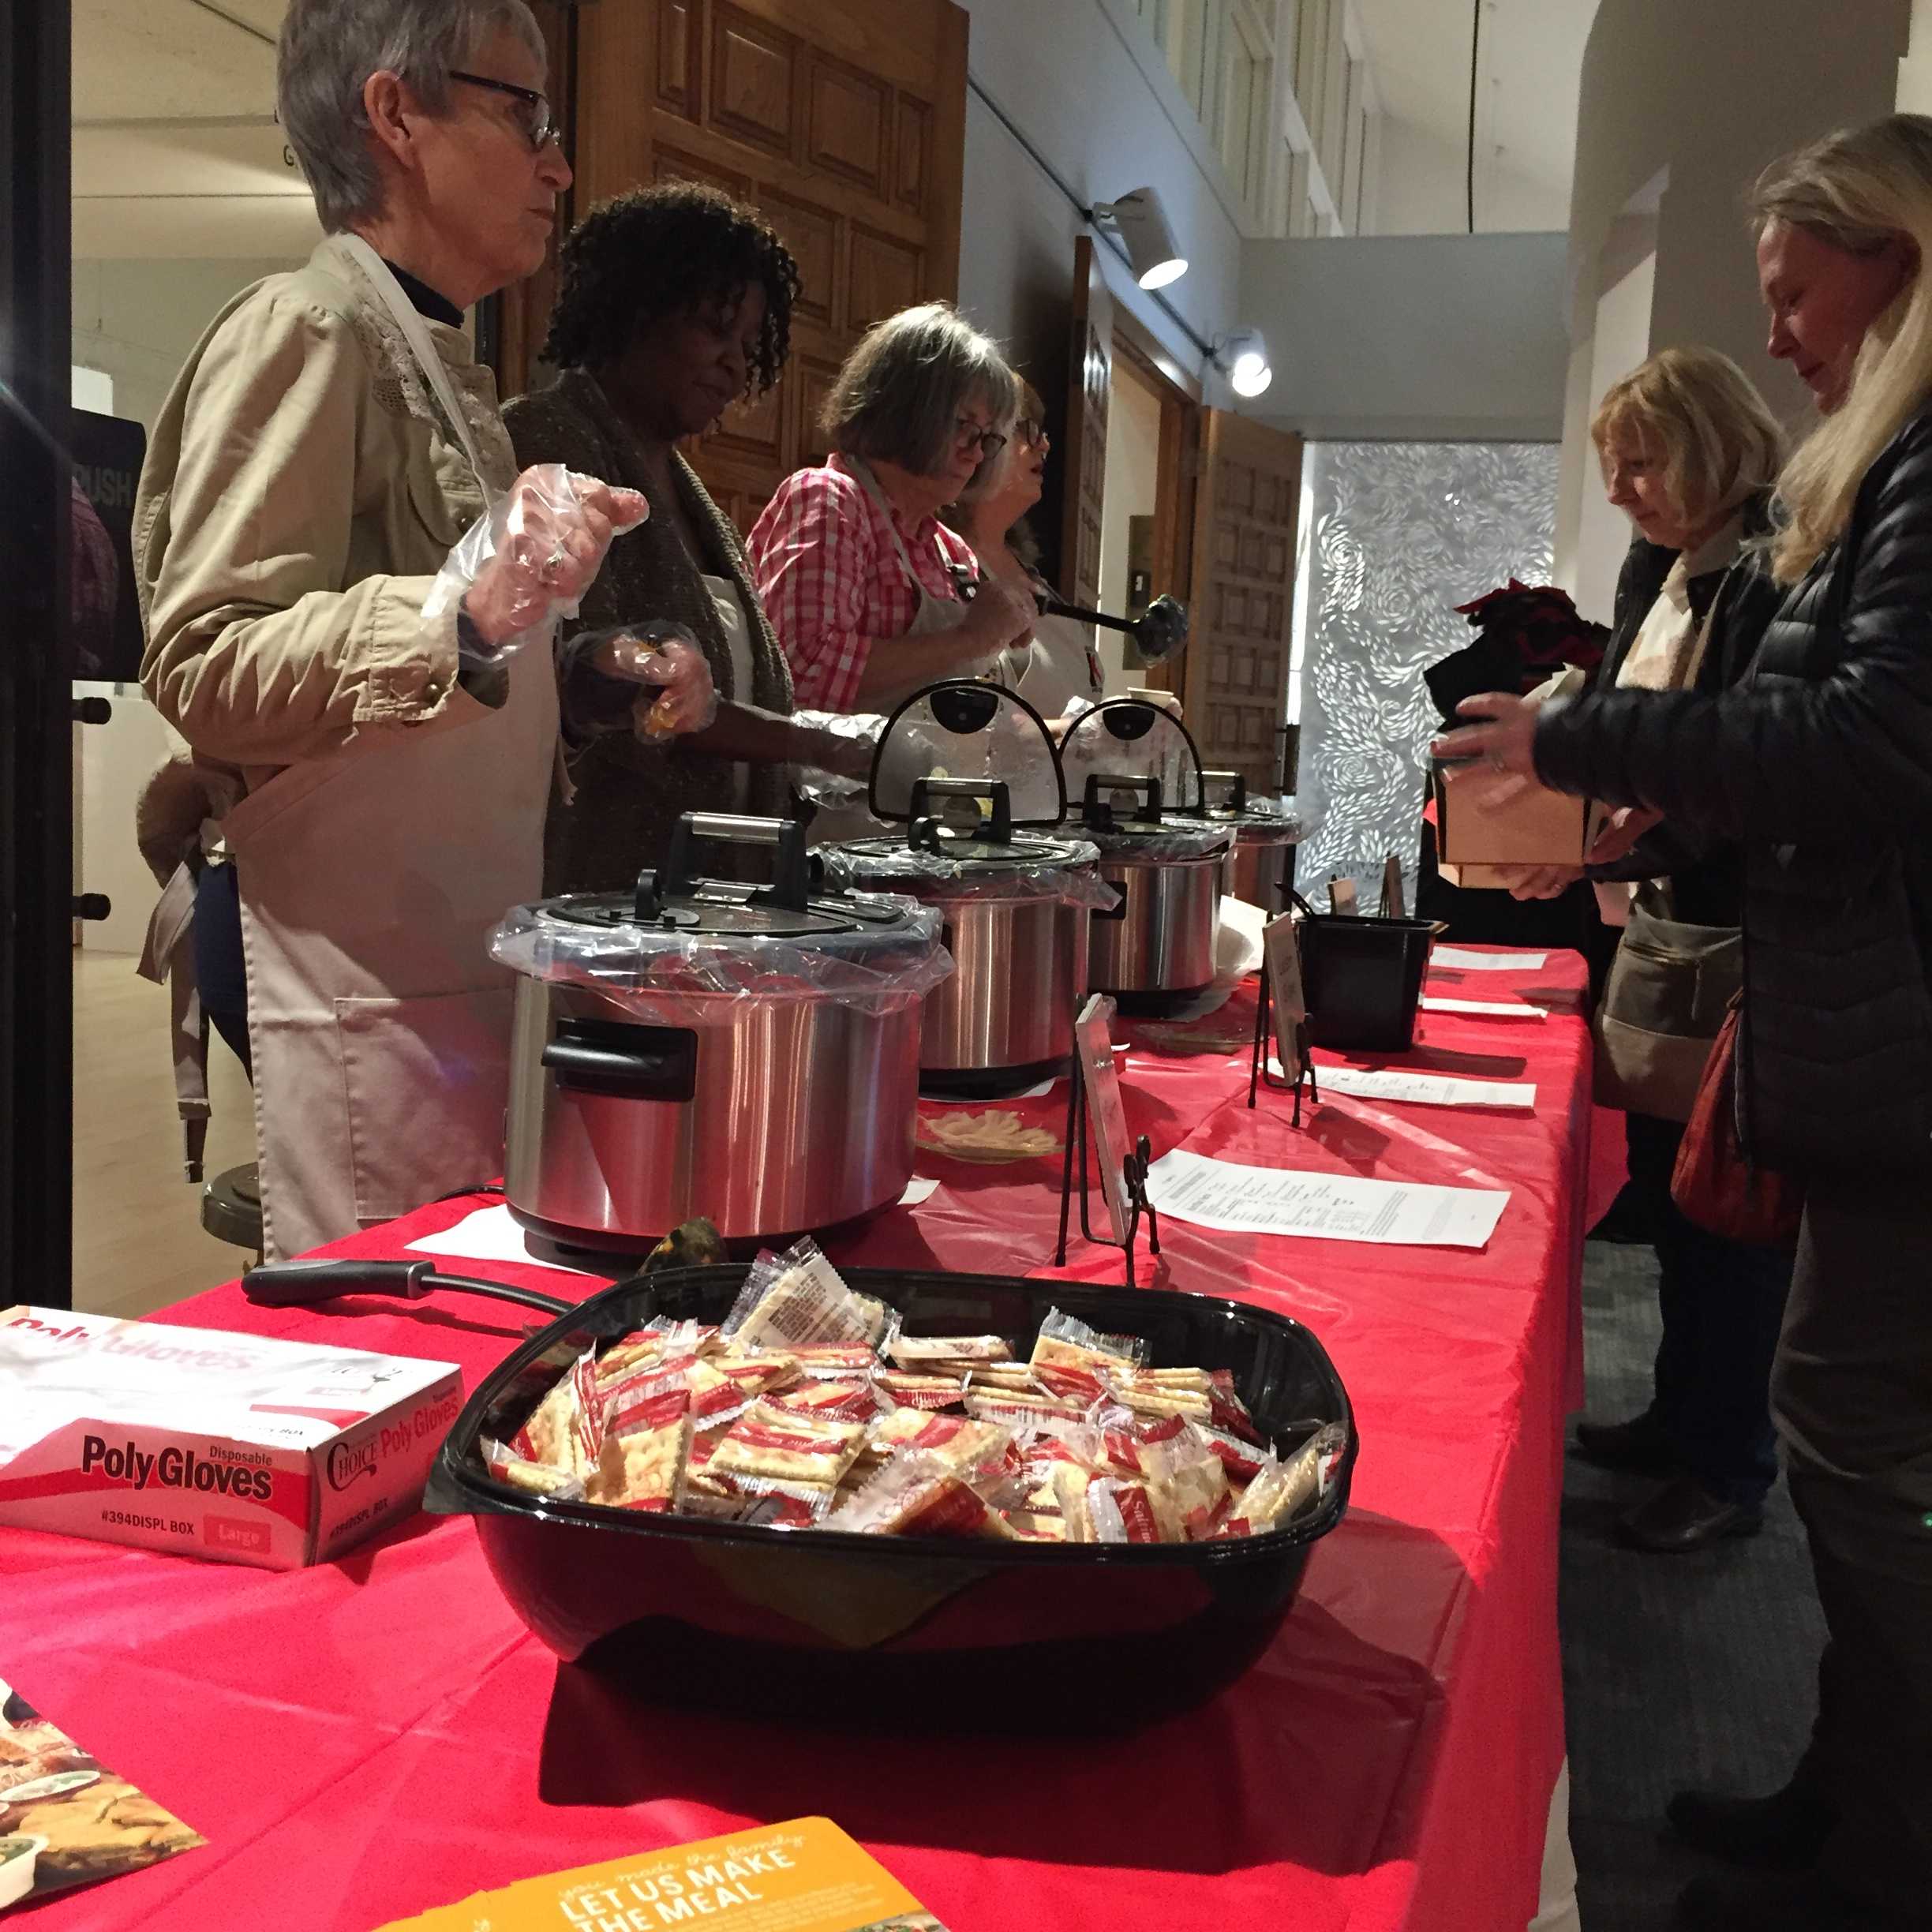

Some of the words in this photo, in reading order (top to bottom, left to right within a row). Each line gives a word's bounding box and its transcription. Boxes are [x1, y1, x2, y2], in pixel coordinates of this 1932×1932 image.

[382, 1419, 410, 1458] Poly
[414, 1397, 459, 1438] Gloves
[82, 1435, 155, 1491] Poly
[158, 1447, 272, 1500] Gloves
[210, 1446, 271, 1466] Disposable
[101, 1510, 167, 1531] #394DISPL
[170, 1519, 195, 1535] BOX
[218, 1523, 260, 1547] Large
[559, 1888, 623, 1921] LET
[628, 1873, 684, 1902] US
[685, 1848, 797, 1889] MAKE
[574, 1908, 655, 1932] THE
[655, 1881, 764, 1924] MEAL
